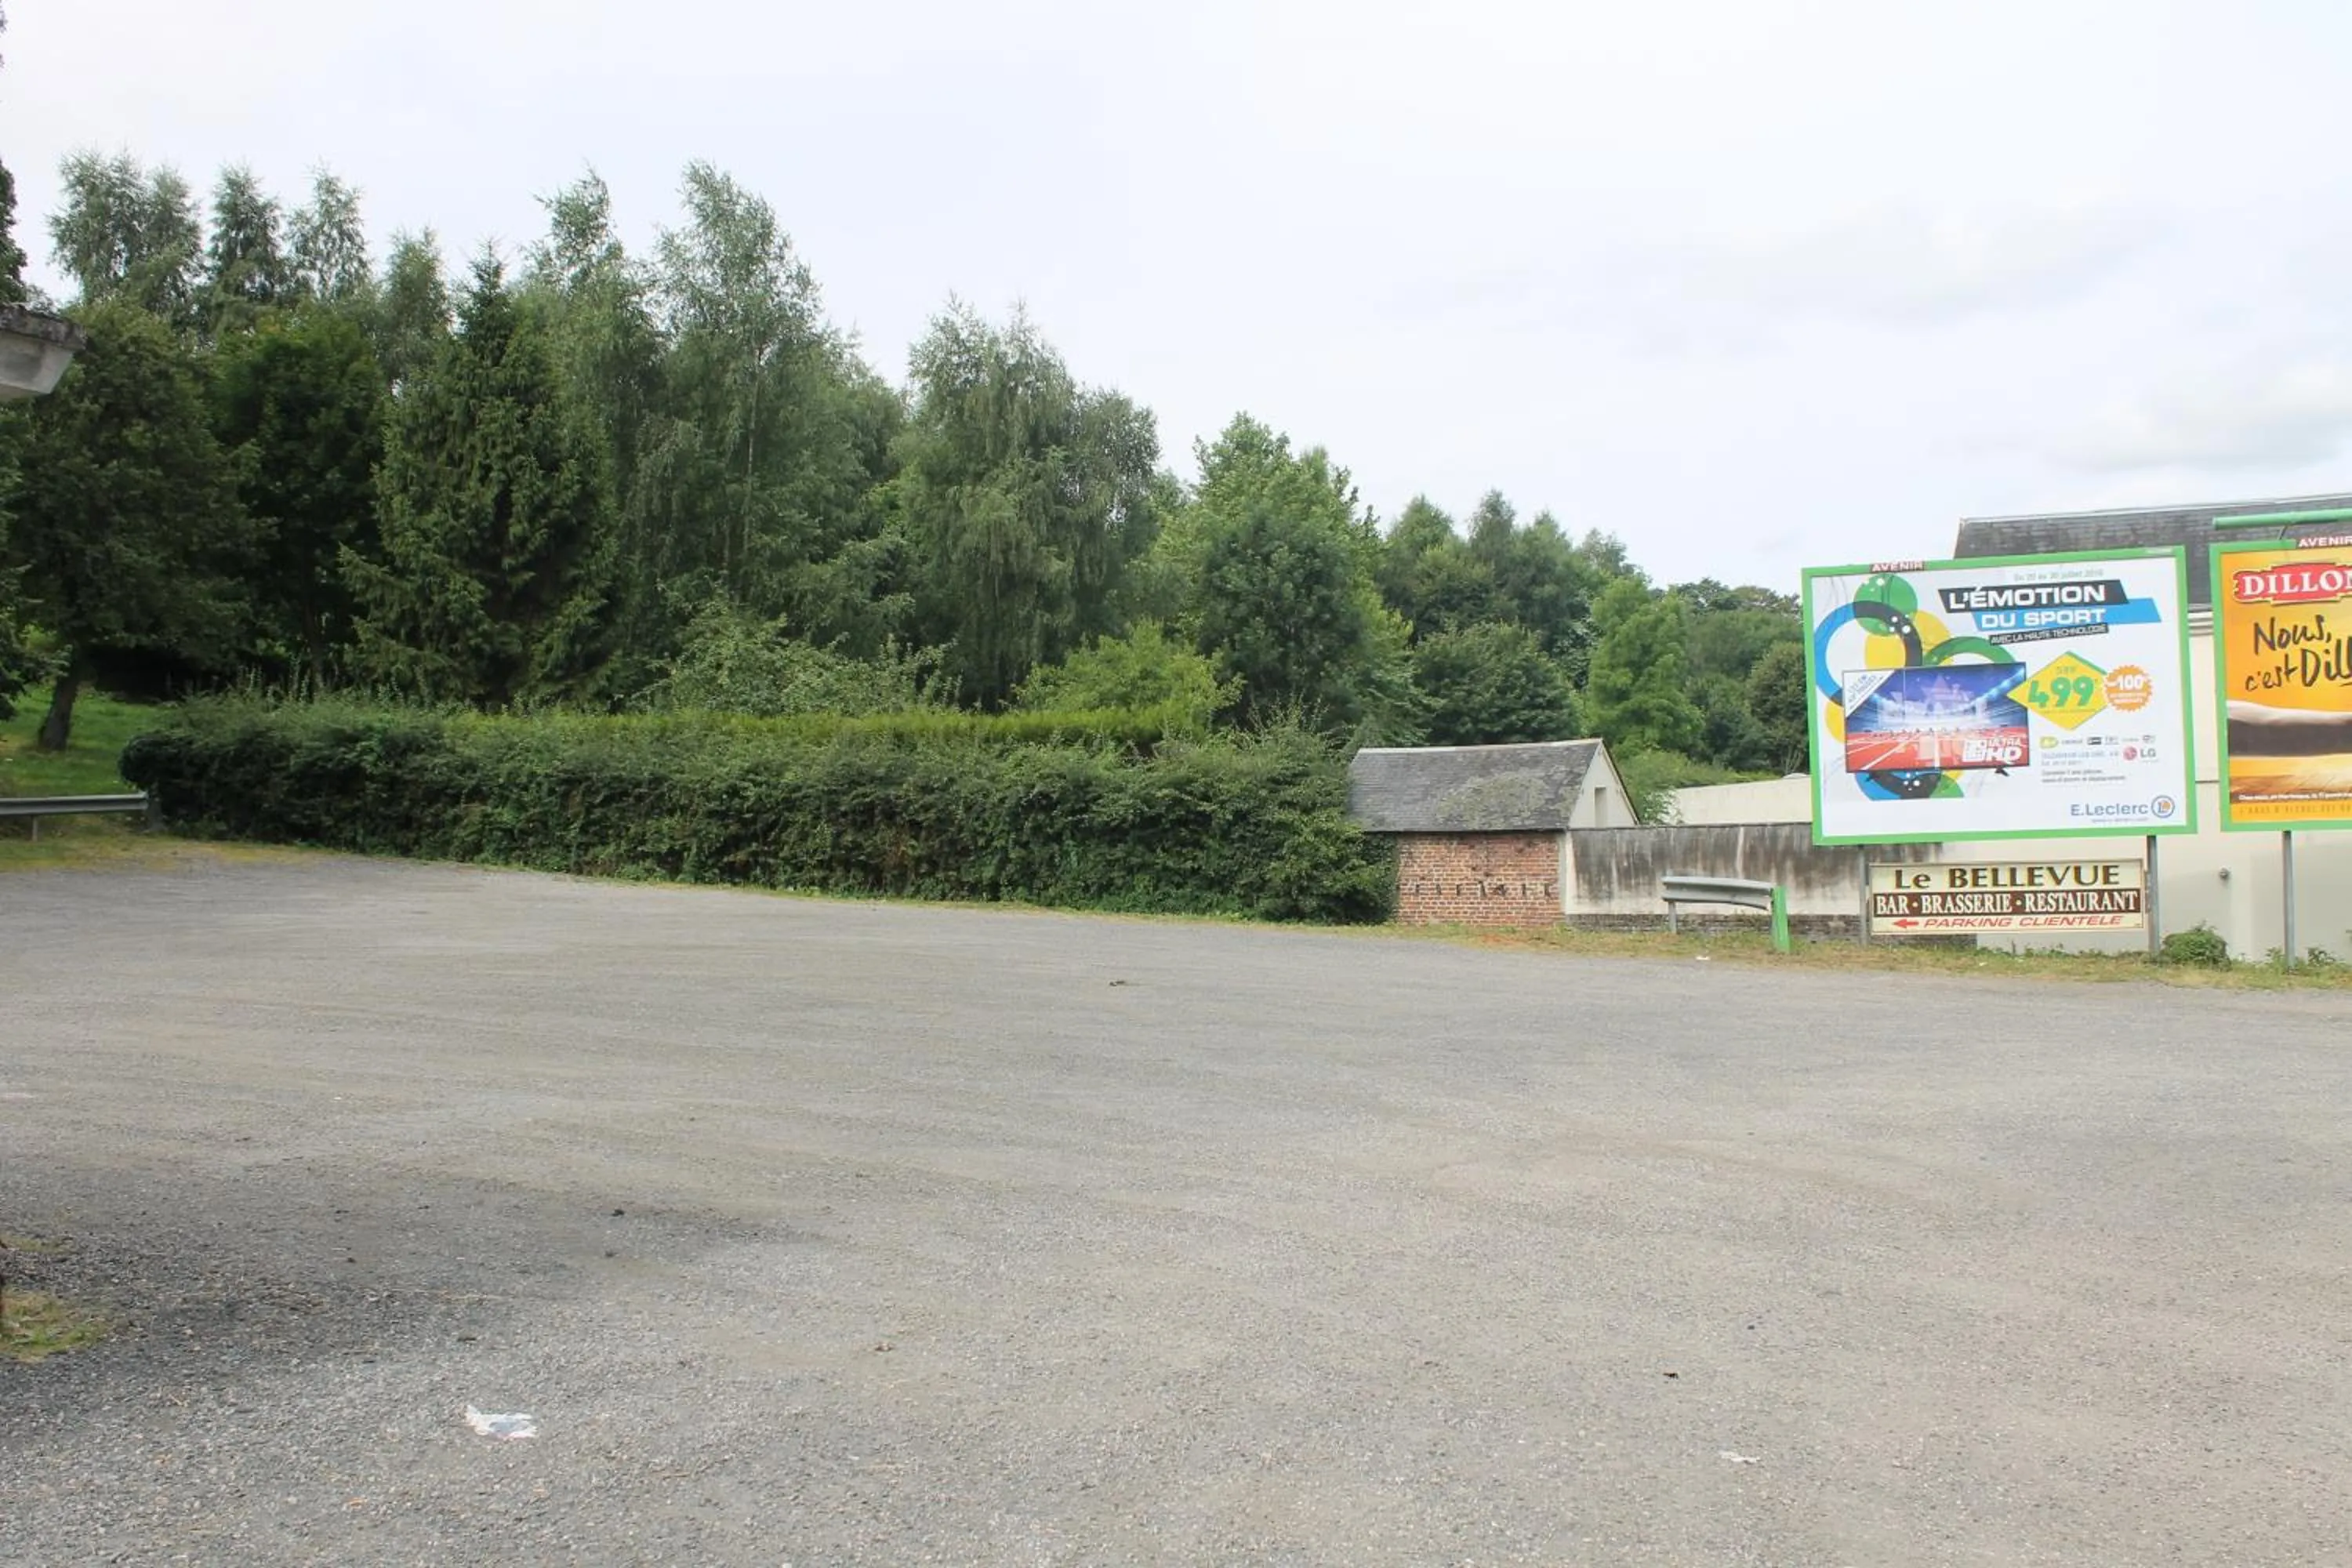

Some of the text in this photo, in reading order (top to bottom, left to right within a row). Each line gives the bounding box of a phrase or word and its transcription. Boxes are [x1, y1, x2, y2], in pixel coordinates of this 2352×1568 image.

[1871, 560, 1923, 572] AVENIR
[1949, 584, 2105, 609] L'ÉMOTION
[1981, 608, 2107, 628] DU SPORT
[2253, 614, 2332, 655] Nous,
[2245, 654, 2298, 692] c'est
[2140, 747, 2156, 758] LG
[2071, 803, 2149, 816] E.Leclerc
[1895, 865, 2120, 889] Le BELLEVUE
[1875, 891, 2138, 915] BAR BRASSERIE RESTAURANT
[1923, 915, 2124, 928] PARKING CLIENTELE
